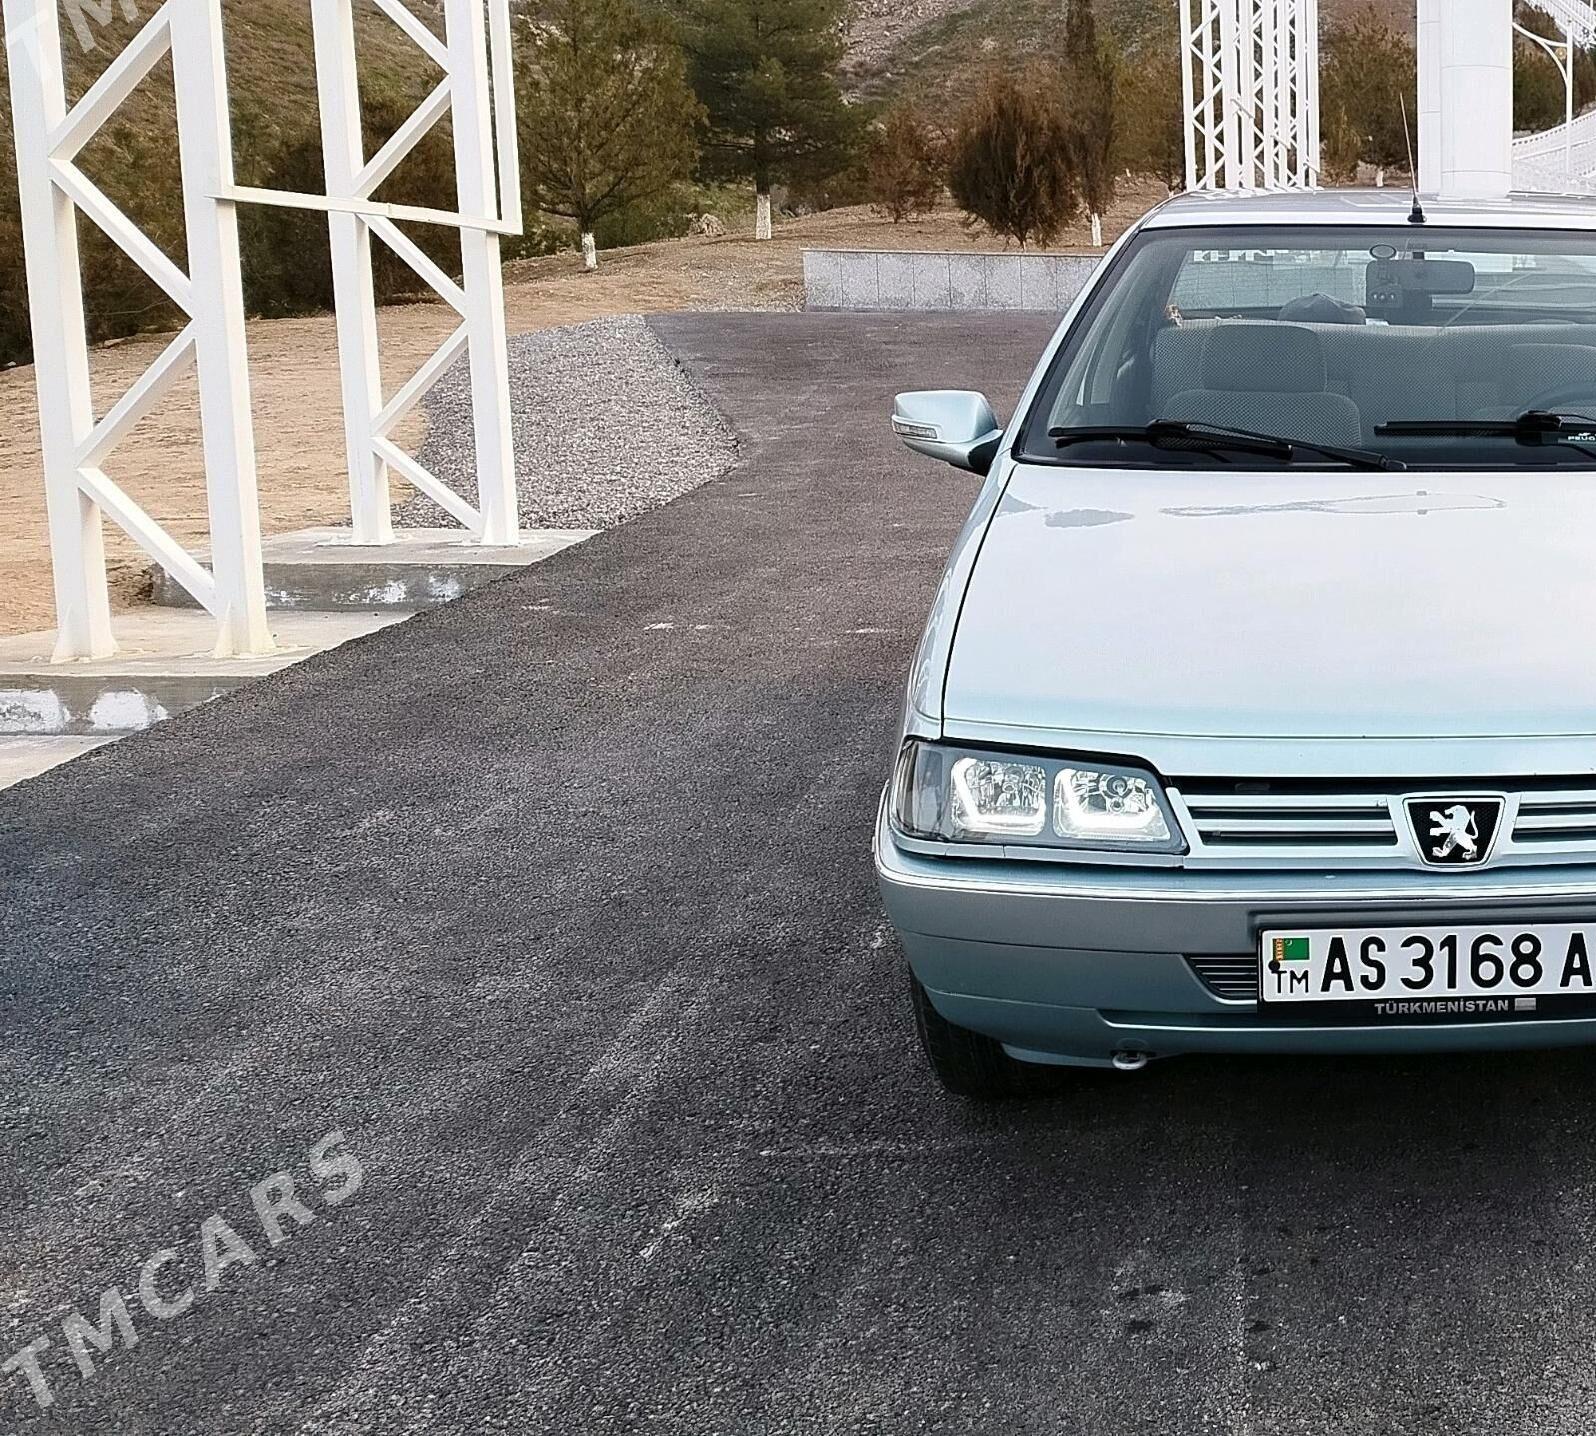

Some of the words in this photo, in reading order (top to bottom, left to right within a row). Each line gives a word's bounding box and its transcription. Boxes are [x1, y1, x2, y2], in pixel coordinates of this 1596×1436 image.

[1320, 935, 1387, 993] AS
[1400, 934, 1543, 990] 3168
[1272, 970, 1309, 994] TM
[1374, 999, 1509, 1015] TÜRKMENİSTAN
